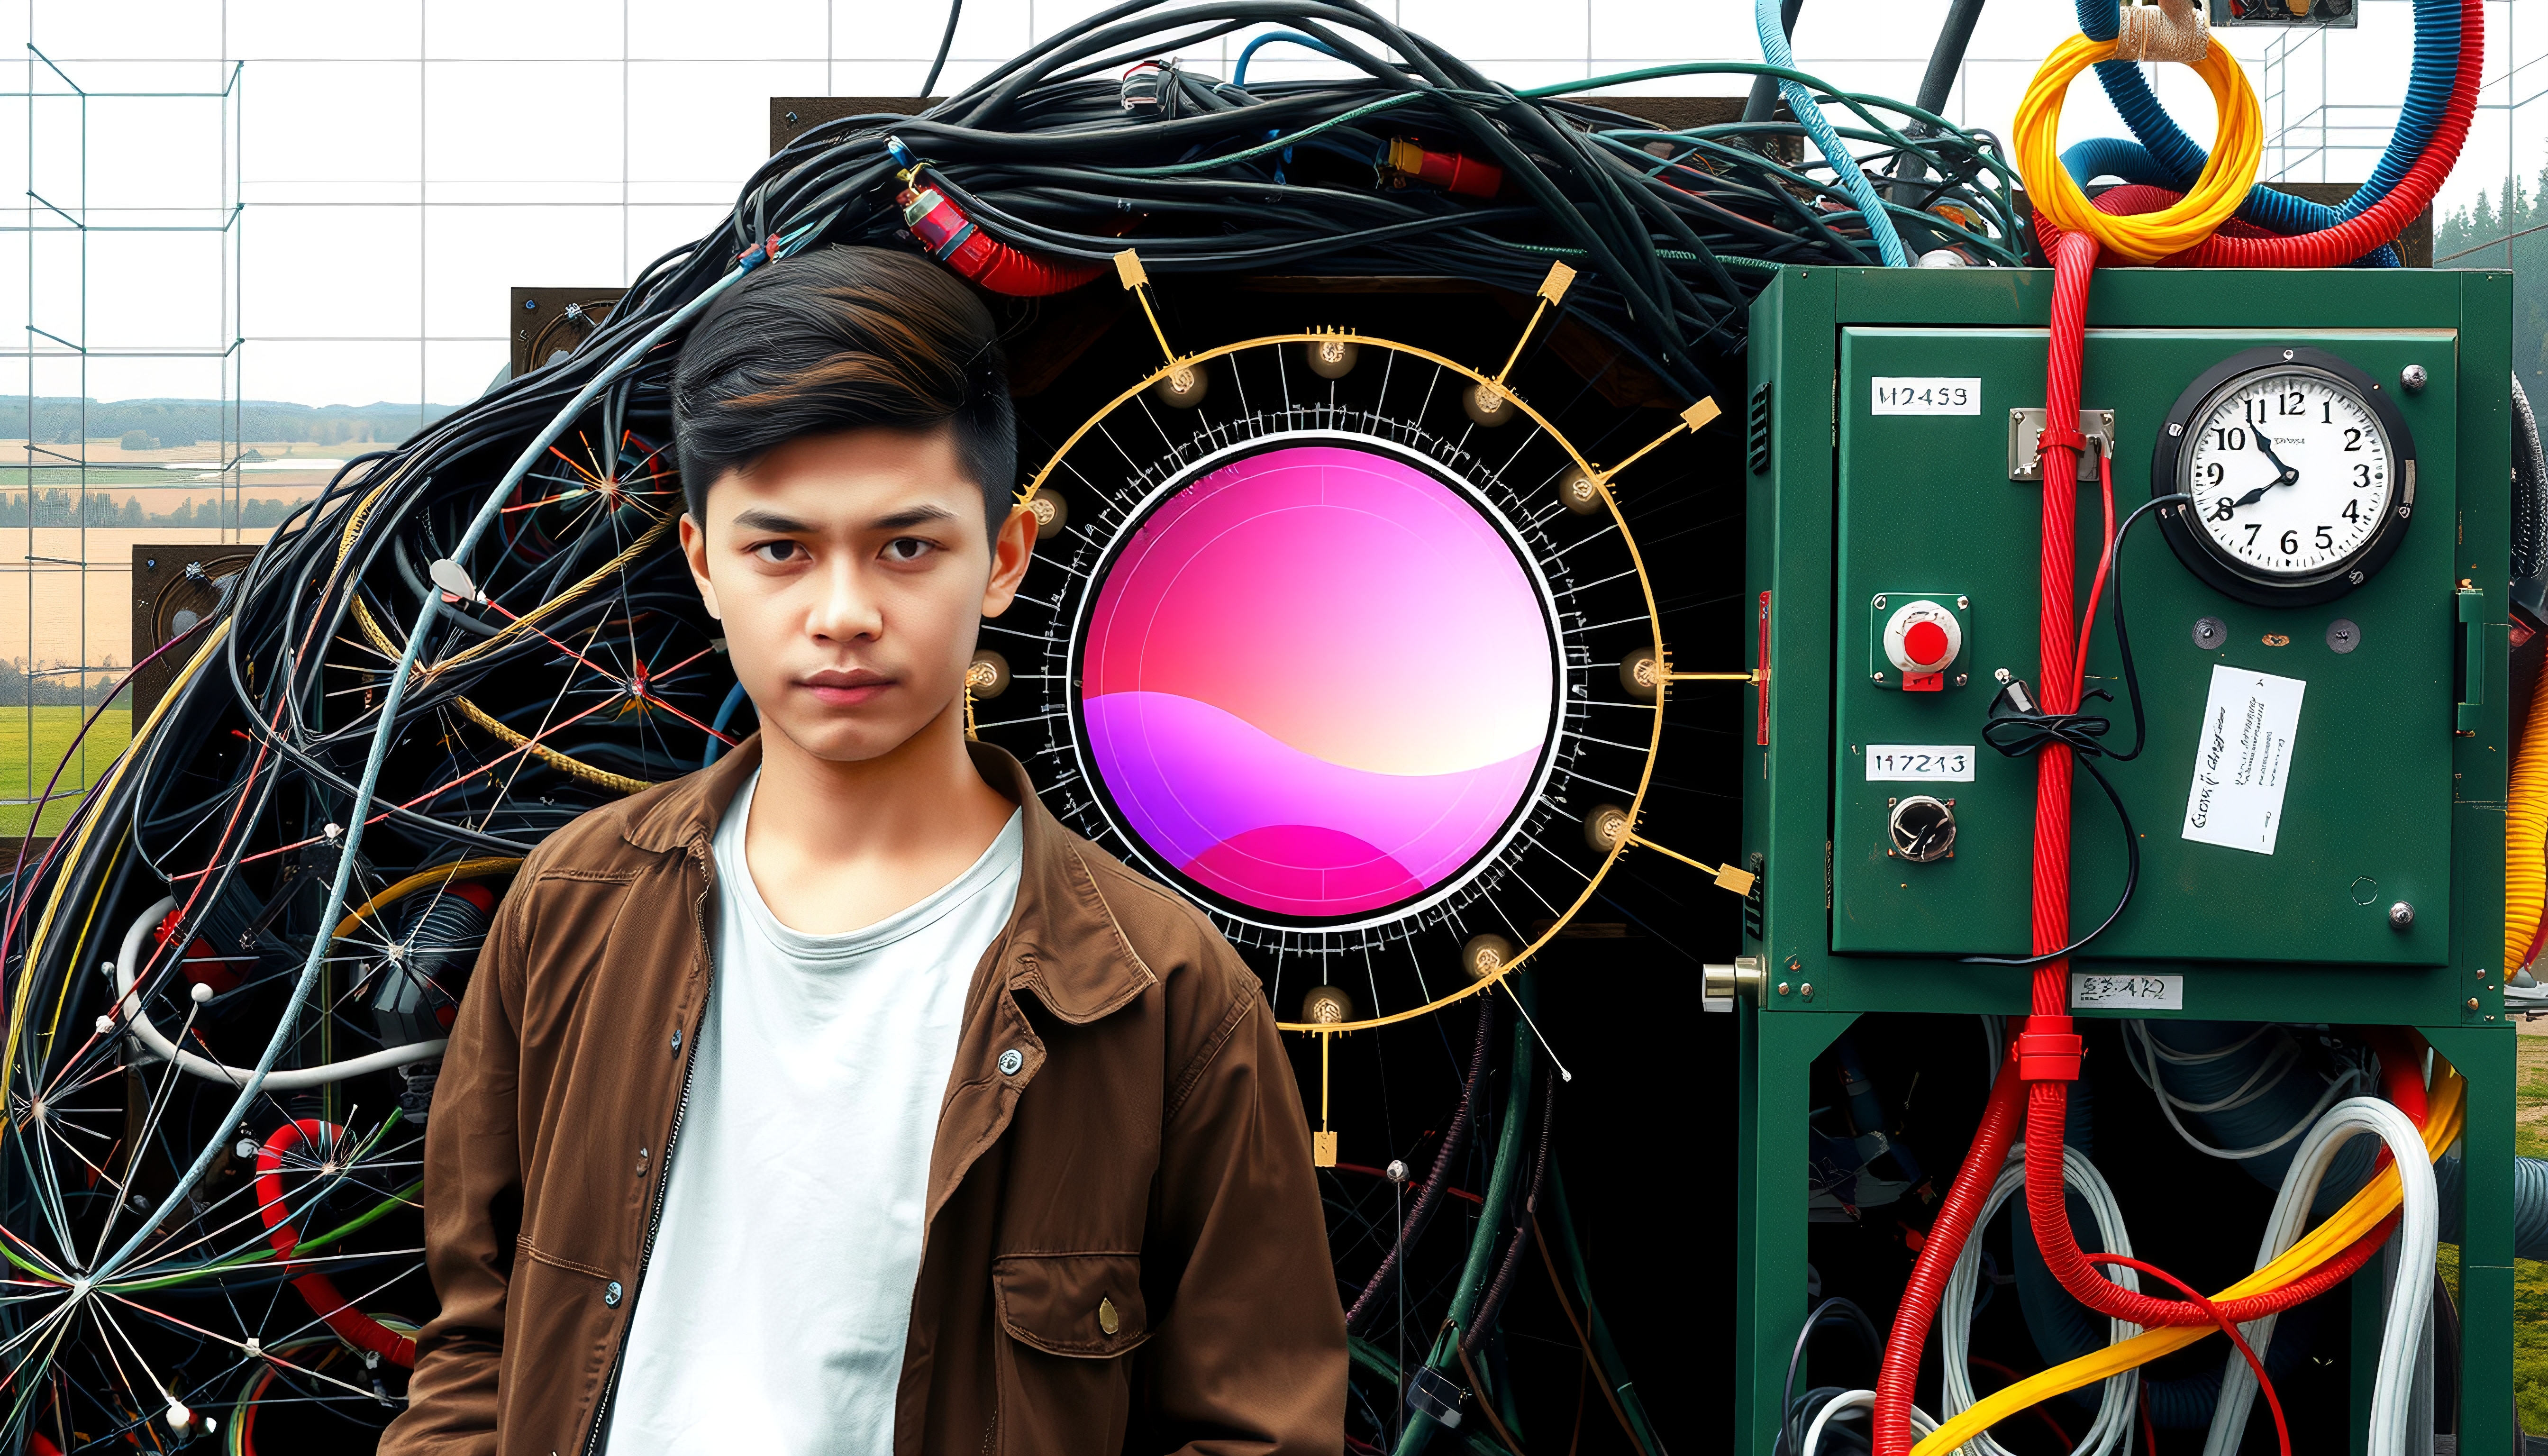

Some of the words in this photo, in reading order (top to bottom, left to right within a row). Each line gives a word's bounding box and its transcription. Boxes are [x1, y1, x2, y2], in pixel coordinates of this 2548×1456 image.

[2244, 398, 2267, 425] 11
[2279, 391, 2306, 416] 12
[2320, 401, 2333, 424] 1
[2210, 427, 2246, 451] 10
[2344, 428, 2362, 452] 2
[2207, 463, 2224, 487] 9
[2353, 464, 2371, 488] 3
[2218, 497, 2235, 521] 8
[2341, 499, 2360, 524] 4
[2244, 524, 2262, 546] 7
[2280, 530, 2298, 555] 6
[2315, 525, 2333, 550] 5
